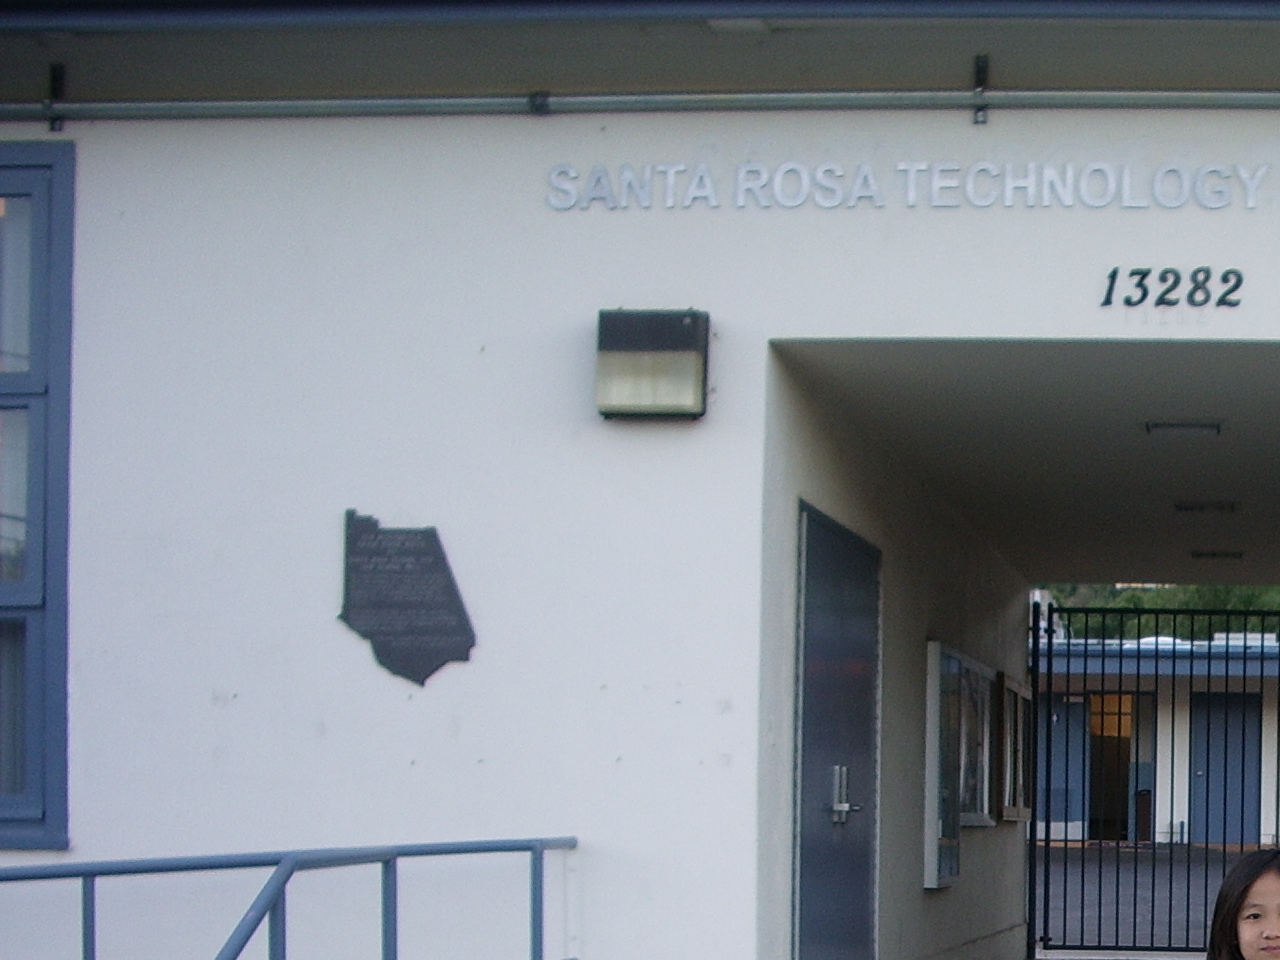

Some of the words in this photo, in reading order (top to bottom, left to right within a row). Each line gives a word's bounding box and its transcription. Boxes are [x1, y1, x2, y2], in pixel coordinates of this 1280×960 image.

[549, 163, 719, 210] SANTA
[735, 161, 884, 208] ROSA
[897, 161, 1271, 209] TECHNOLOGY
[1100, 266, 1243, 307] 13282
